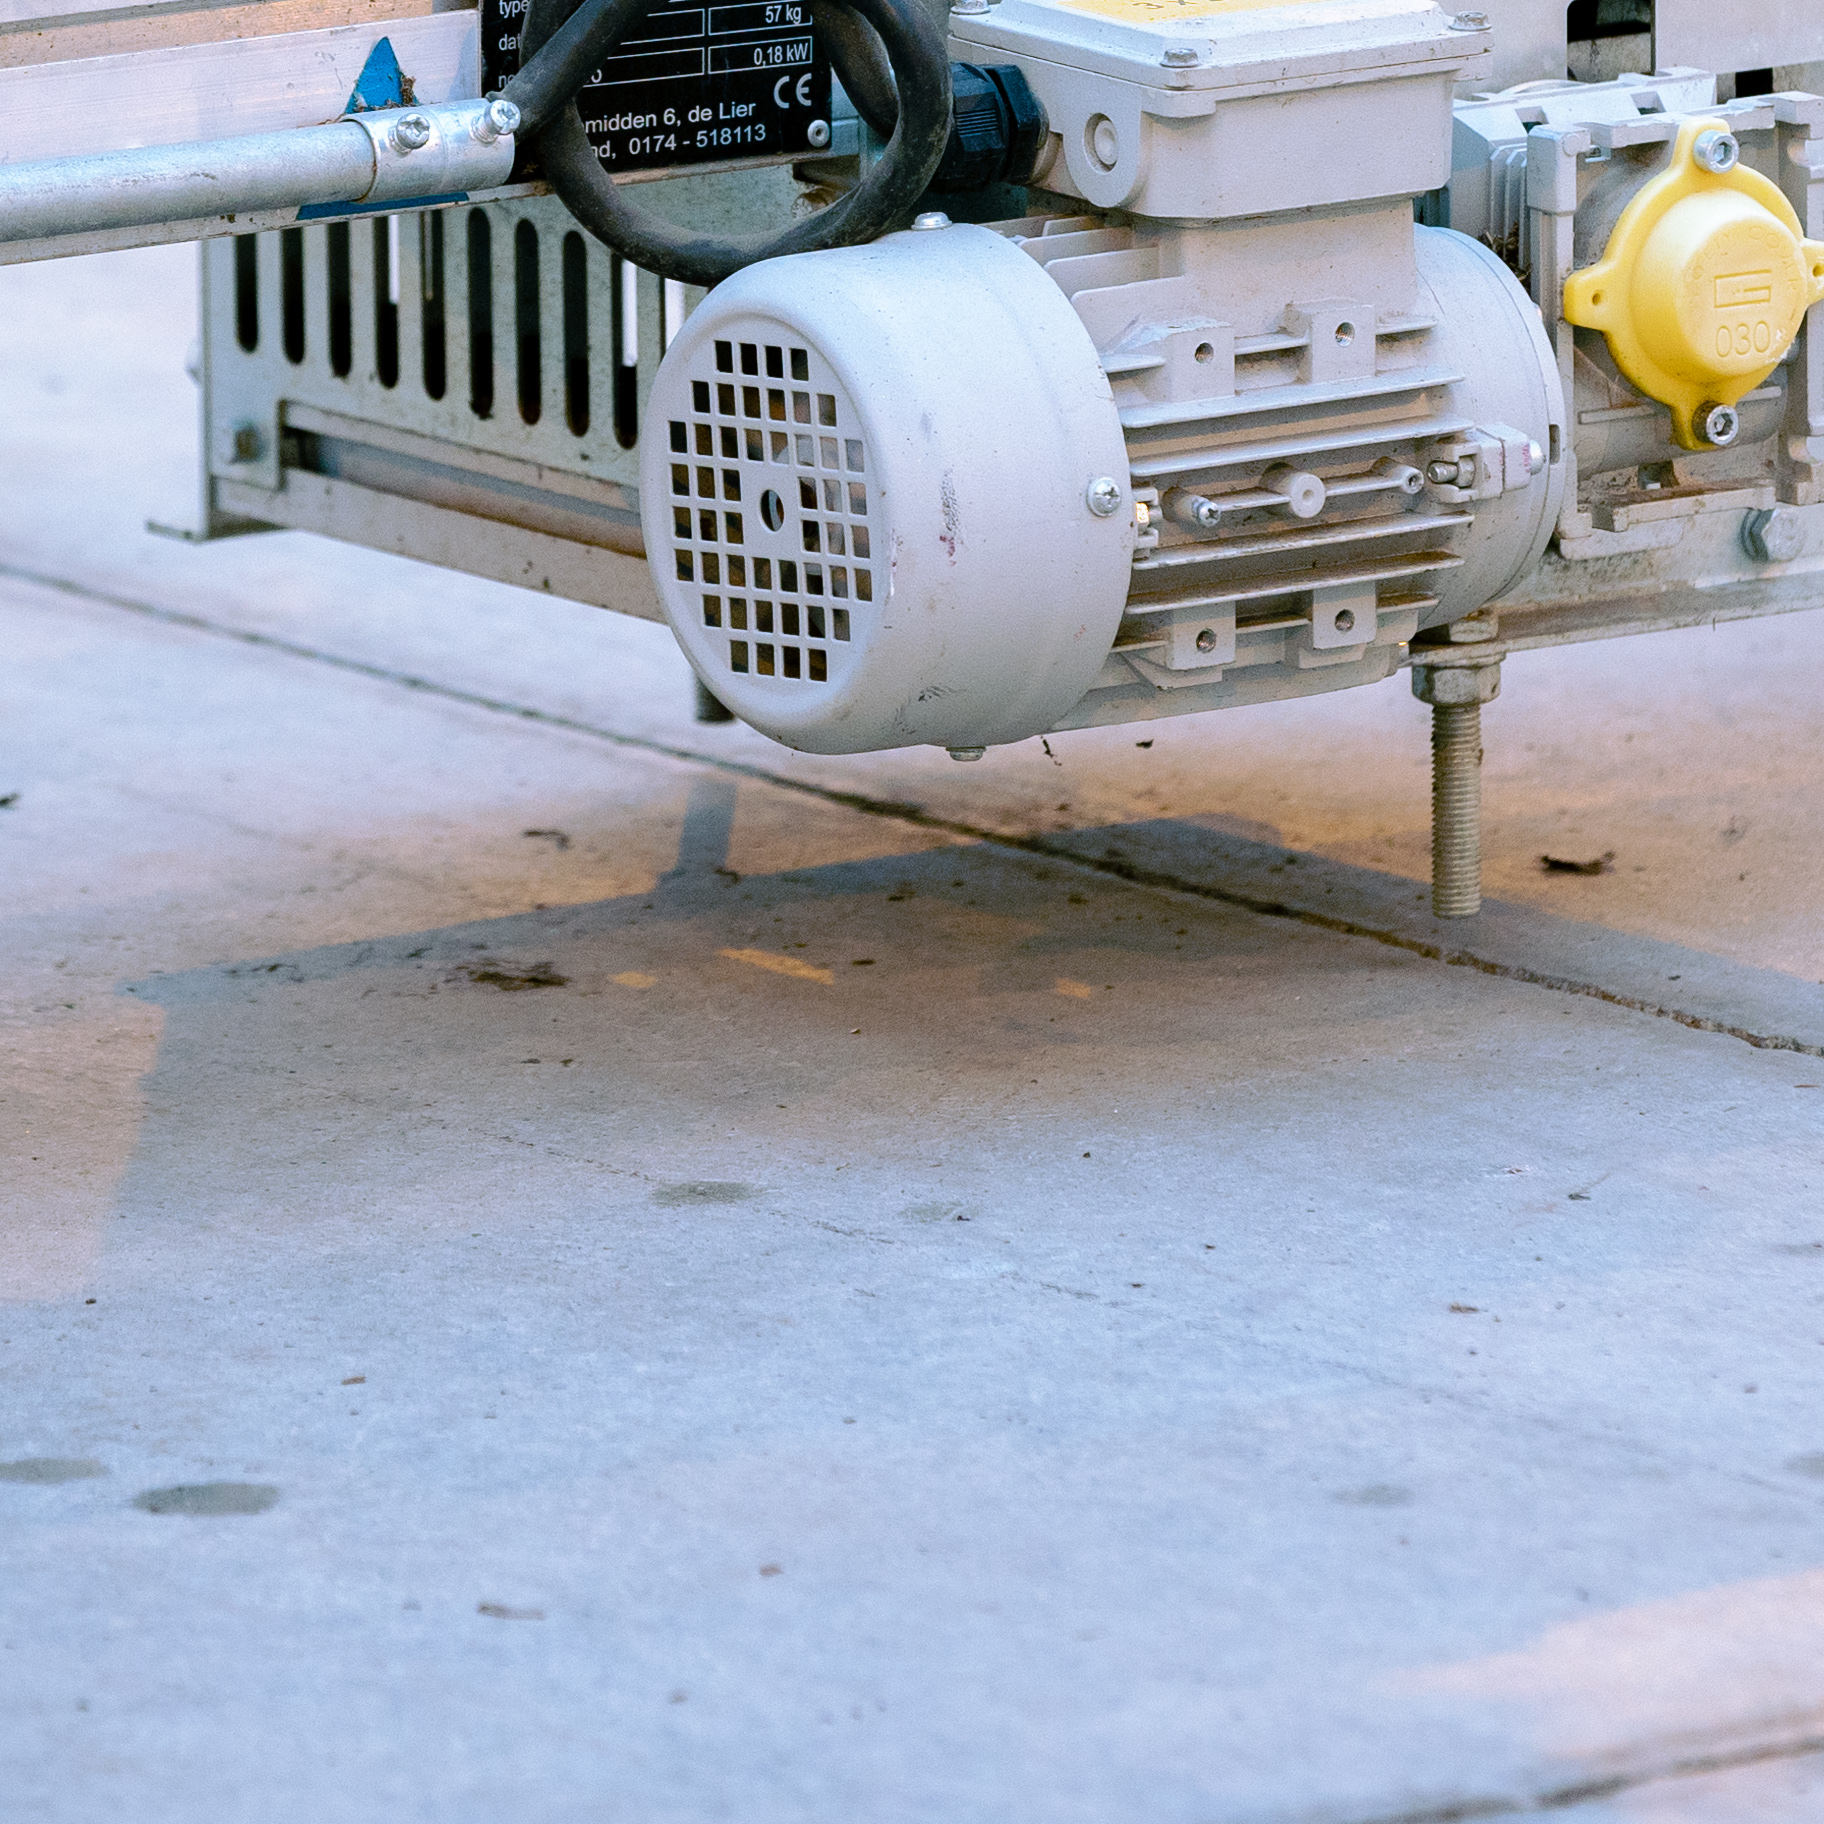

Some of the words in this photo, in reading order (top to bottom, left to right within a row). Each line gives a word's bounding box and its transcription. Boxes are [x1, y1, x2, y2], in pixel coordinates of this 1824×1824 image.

[765, 4, 783, 24] 57
[785, 3, 802, 26] kg
[753, 45, 783, 67] 0,18
[786, 42, 809, 62] kW
[663, 108, 681, 128] 6,
[687, 105, 713, 123] de
[719, 101, 757, 120] Lier
[629, 133, 677, 155] 0174
[695, 124, 767, 148] 518113
[1715, 319, 1771, 359] 030
